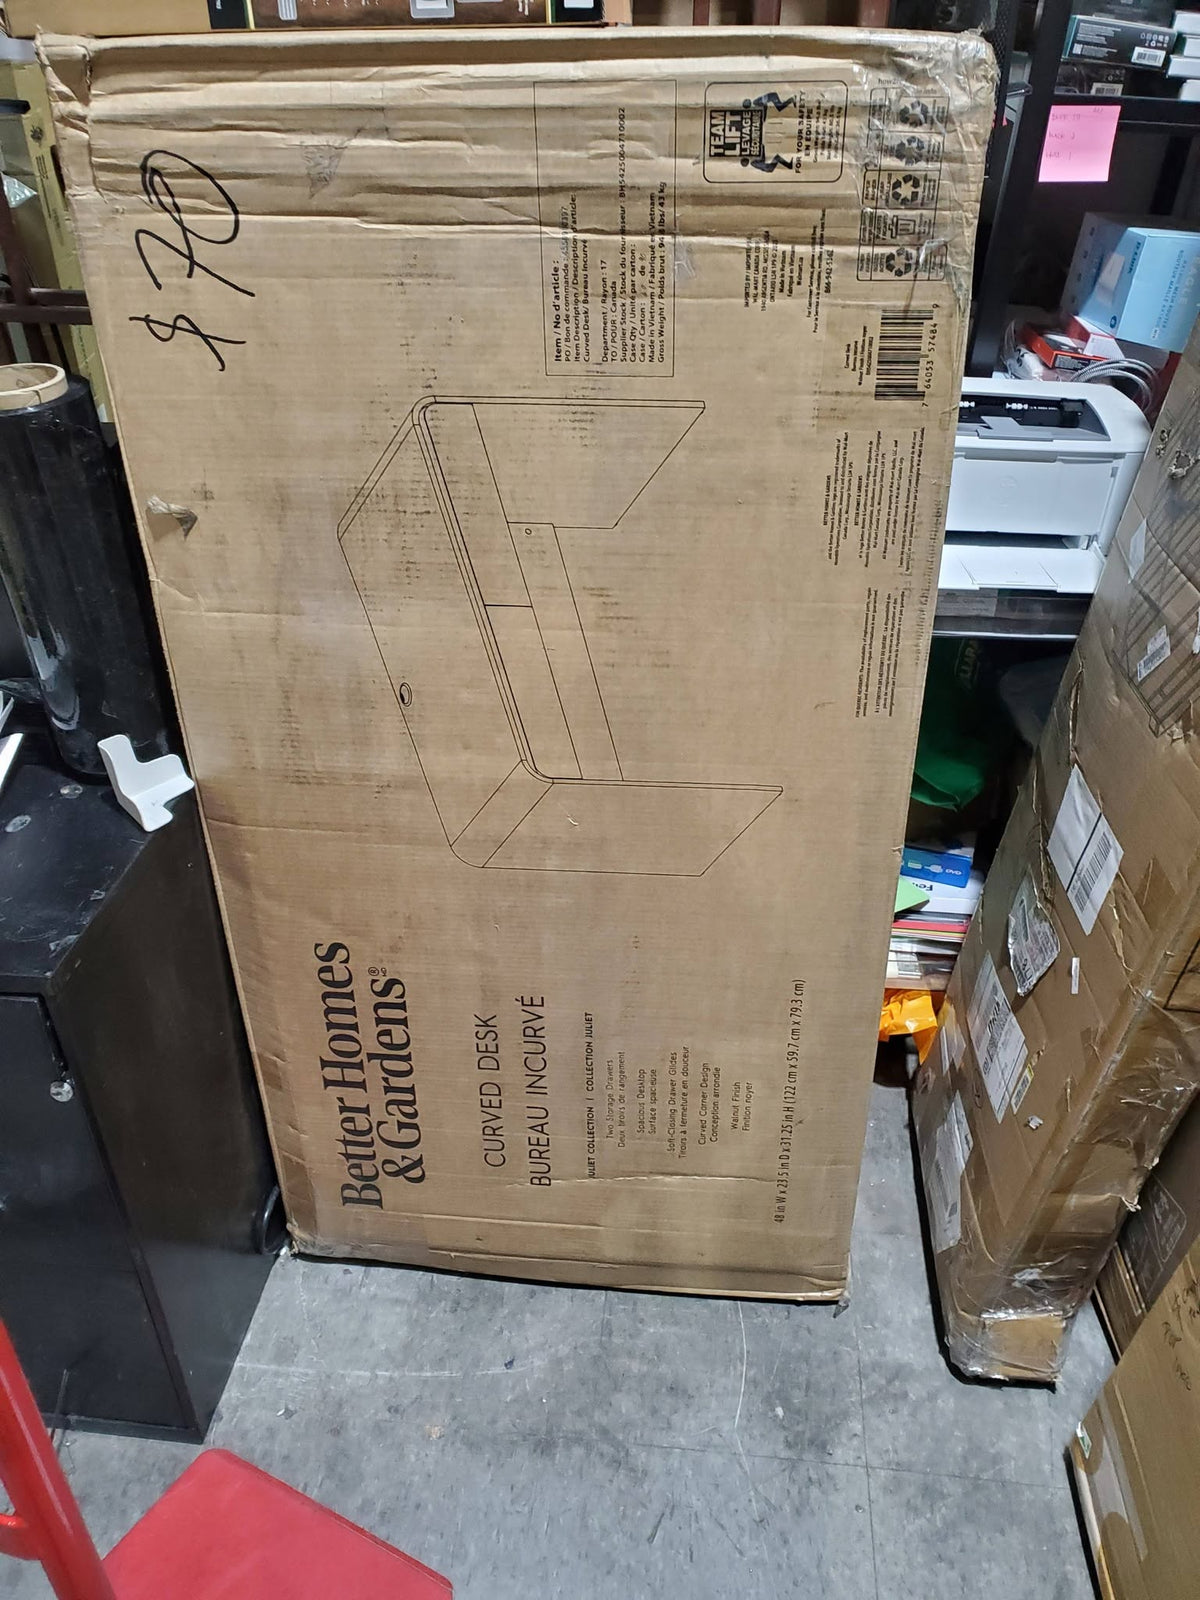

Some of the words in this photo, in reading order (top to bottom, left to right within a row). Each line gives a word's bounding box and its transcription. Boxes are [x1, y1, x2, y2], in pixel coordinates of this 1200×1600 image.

[711, 112, 724, 155] TEAM
[725, 112, 740, 155] LIFT
[742, 112, 750, 154] LEVAGE
[805, 145, 810, 156] EN
[659, 182, 666, 193] kg
[658, 197, 664, 207] 43
[571, 235, 579, 285] Description
[601, 260, 606, 270] 17
[620, 258, 626, 269] du
[639, 266, 645, 276] de
[554, 314, 560, 328] No
[564, 314, 570, 324] de
[658, 308, 666, 337] Weight
[620, 328, 628, 362] Supplier
[928, 323, 938, 352] 57484
[565, 350, 570, 361] PO
[611, 351, 617, 362] TO
[924, 360, 934, 389] 64053
[792, 980, 806, 996] cm)
[314, 942, 368, 1093] Homes
[790, 1000, 802, 1017] 79.3
[585, 1012, 593, 1038] JULIET
[791, 1029, 800, 1040] cm
[474, 1014, 500, 1071] DESK
[515, 996, 547, 1095] INCURVÉ
[787, 1043, 799, 1061] 59.7
[586, 1042, 594, 1091] COLLECTION
[618, 1052, 627, 1091] rangement
[669, 1052, 677, 1075] Glides
[700, 1063, 710, 1088] Design
[637, 1069, 646, 1098] Desktop
[649, 1069, 658, 1104] spacieuse
[682, 1081, 688, 1089] en
[712, 1067, 720, 1098] arrondie
[788, 1072, 797, 1083] cm
[618, 1095, 625, 1103] de
[668, 1080, 676, 1105] Drawer
[699, 1092, 708, 1116] Corner
[732, 1082, 740, 1101] Finish
[746, 1082, 754, 1103] noyer
[783, 1086, 796, 1103] (122
[606, 1094, 615, 1121] Storage
[637, 1103, 646, 1133] Spacious
[679, 1092, 688, 1126] fermeture
[731, 1106, 739, 1129] Walnut
[742, 1106, 751, 1131] Finition
[480, 1082, 506, 1167] CURVED
[587, 1107, 595, 1154] COLLECTION
[606, 1125, 614, 1138] Two
[648, 1108, 656, 1134] Surface
[667, 1109, 677, 1151] Soft-Closing
[698, 1120, 706, 1145] Curved
[710, 1102, 719, 1142] Conception
[526, 1106, 551, 1186] BUREAU
[679, 1138, 687, 1158] Tiroirs
[780, 1125, 792, 1146] 31.25
[335, 1097, 383, 1209] Better
[381, 1154, 425, 1183] &
[588, 1157, 596, 1179] JULIET
[777, 1172, 788, 1188] 23.5
[774, 1215, 784, 1223] 48
